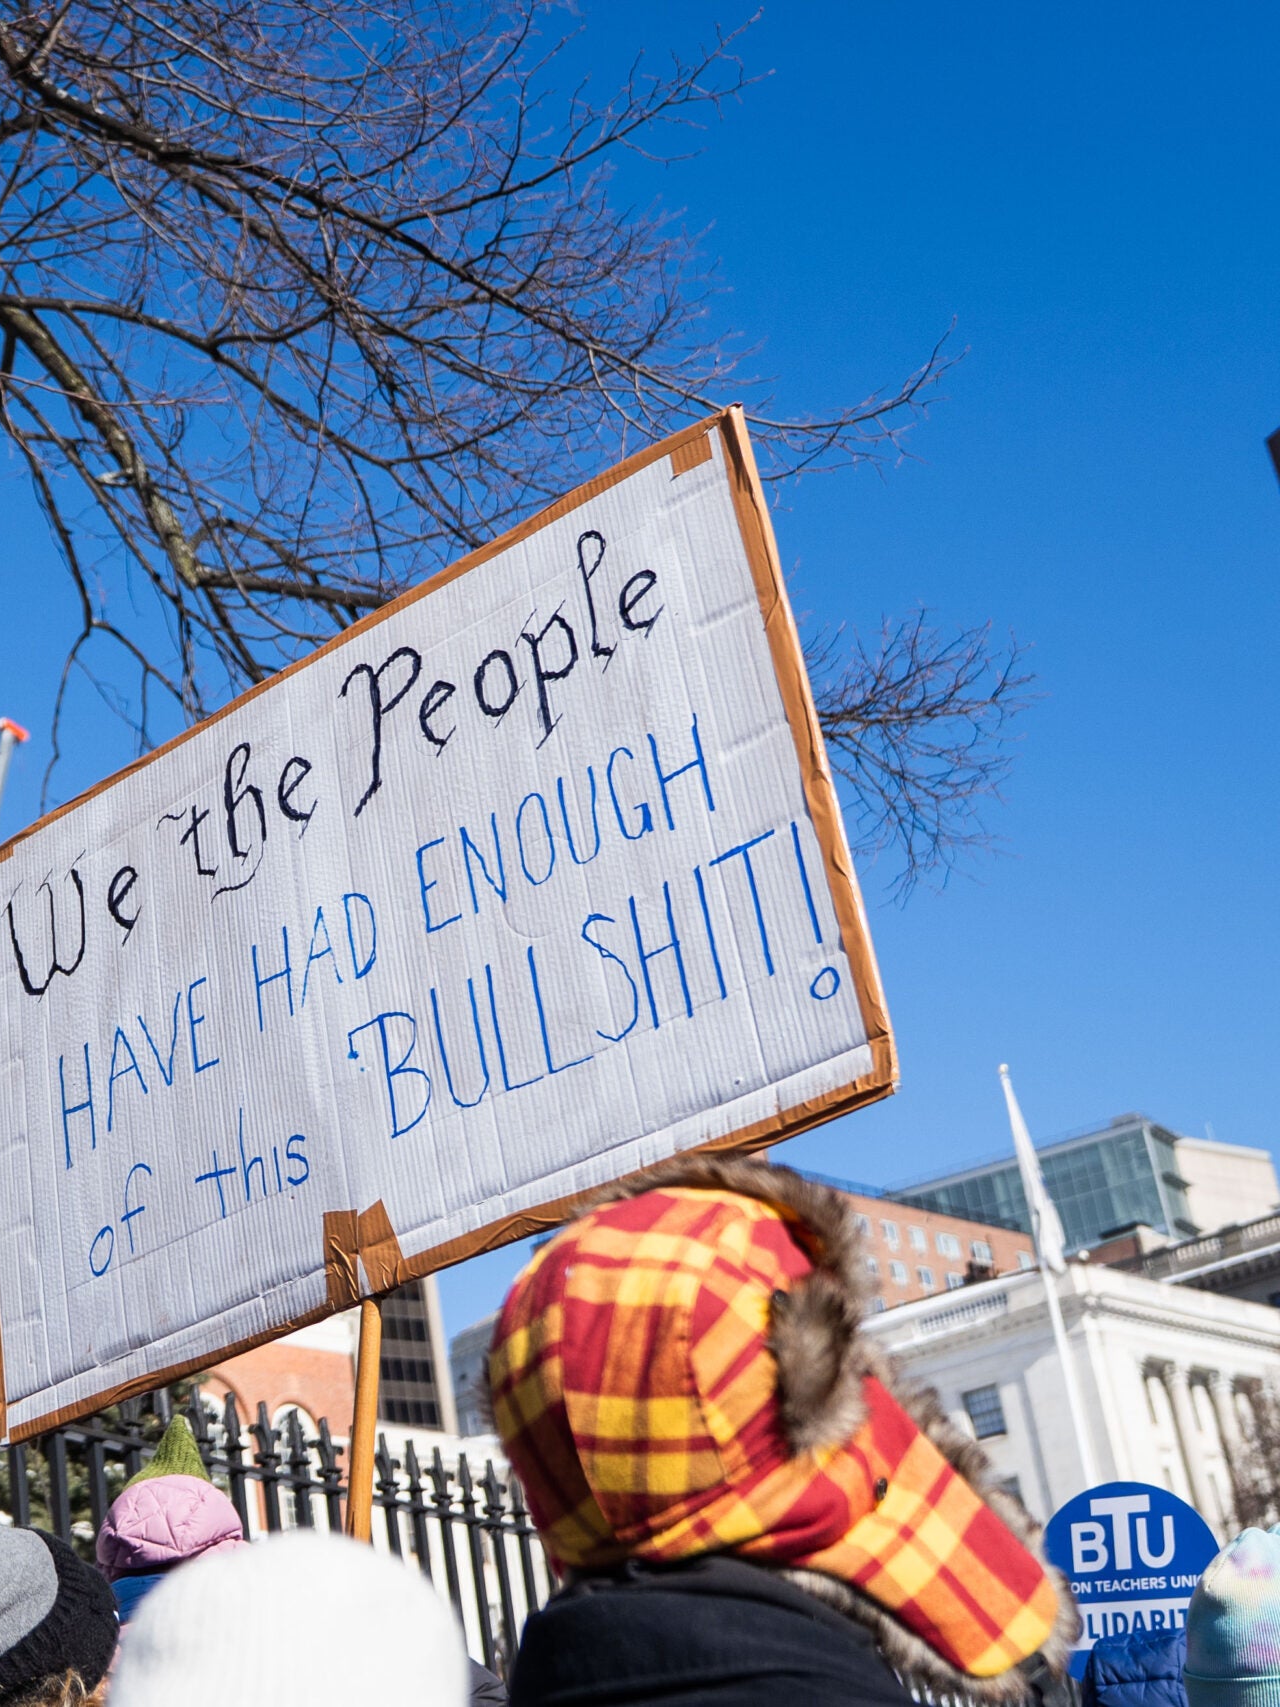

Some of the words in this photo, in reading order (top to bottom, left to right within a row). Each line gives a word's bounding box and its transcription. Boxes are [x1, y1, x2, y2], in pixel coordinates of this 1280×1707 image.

[4, 856, 142, 998] We
[158, 742, 319, 903] the
[338, 528, 665, 818] People
[58, 976, 221, 1169] HAVE
[250, 892, 377, 1032] HAD
[416, 713, 717, 934] ENOUGH
[89, 1163, 153, 1277] of
[195, 1107, 311, 1218] this
[1070, 1494, 1176, 1573] BTU
[1094, 1577, 1167, 1593] TEACHERS
[1170, 1574, 1202, 1589] UNI
